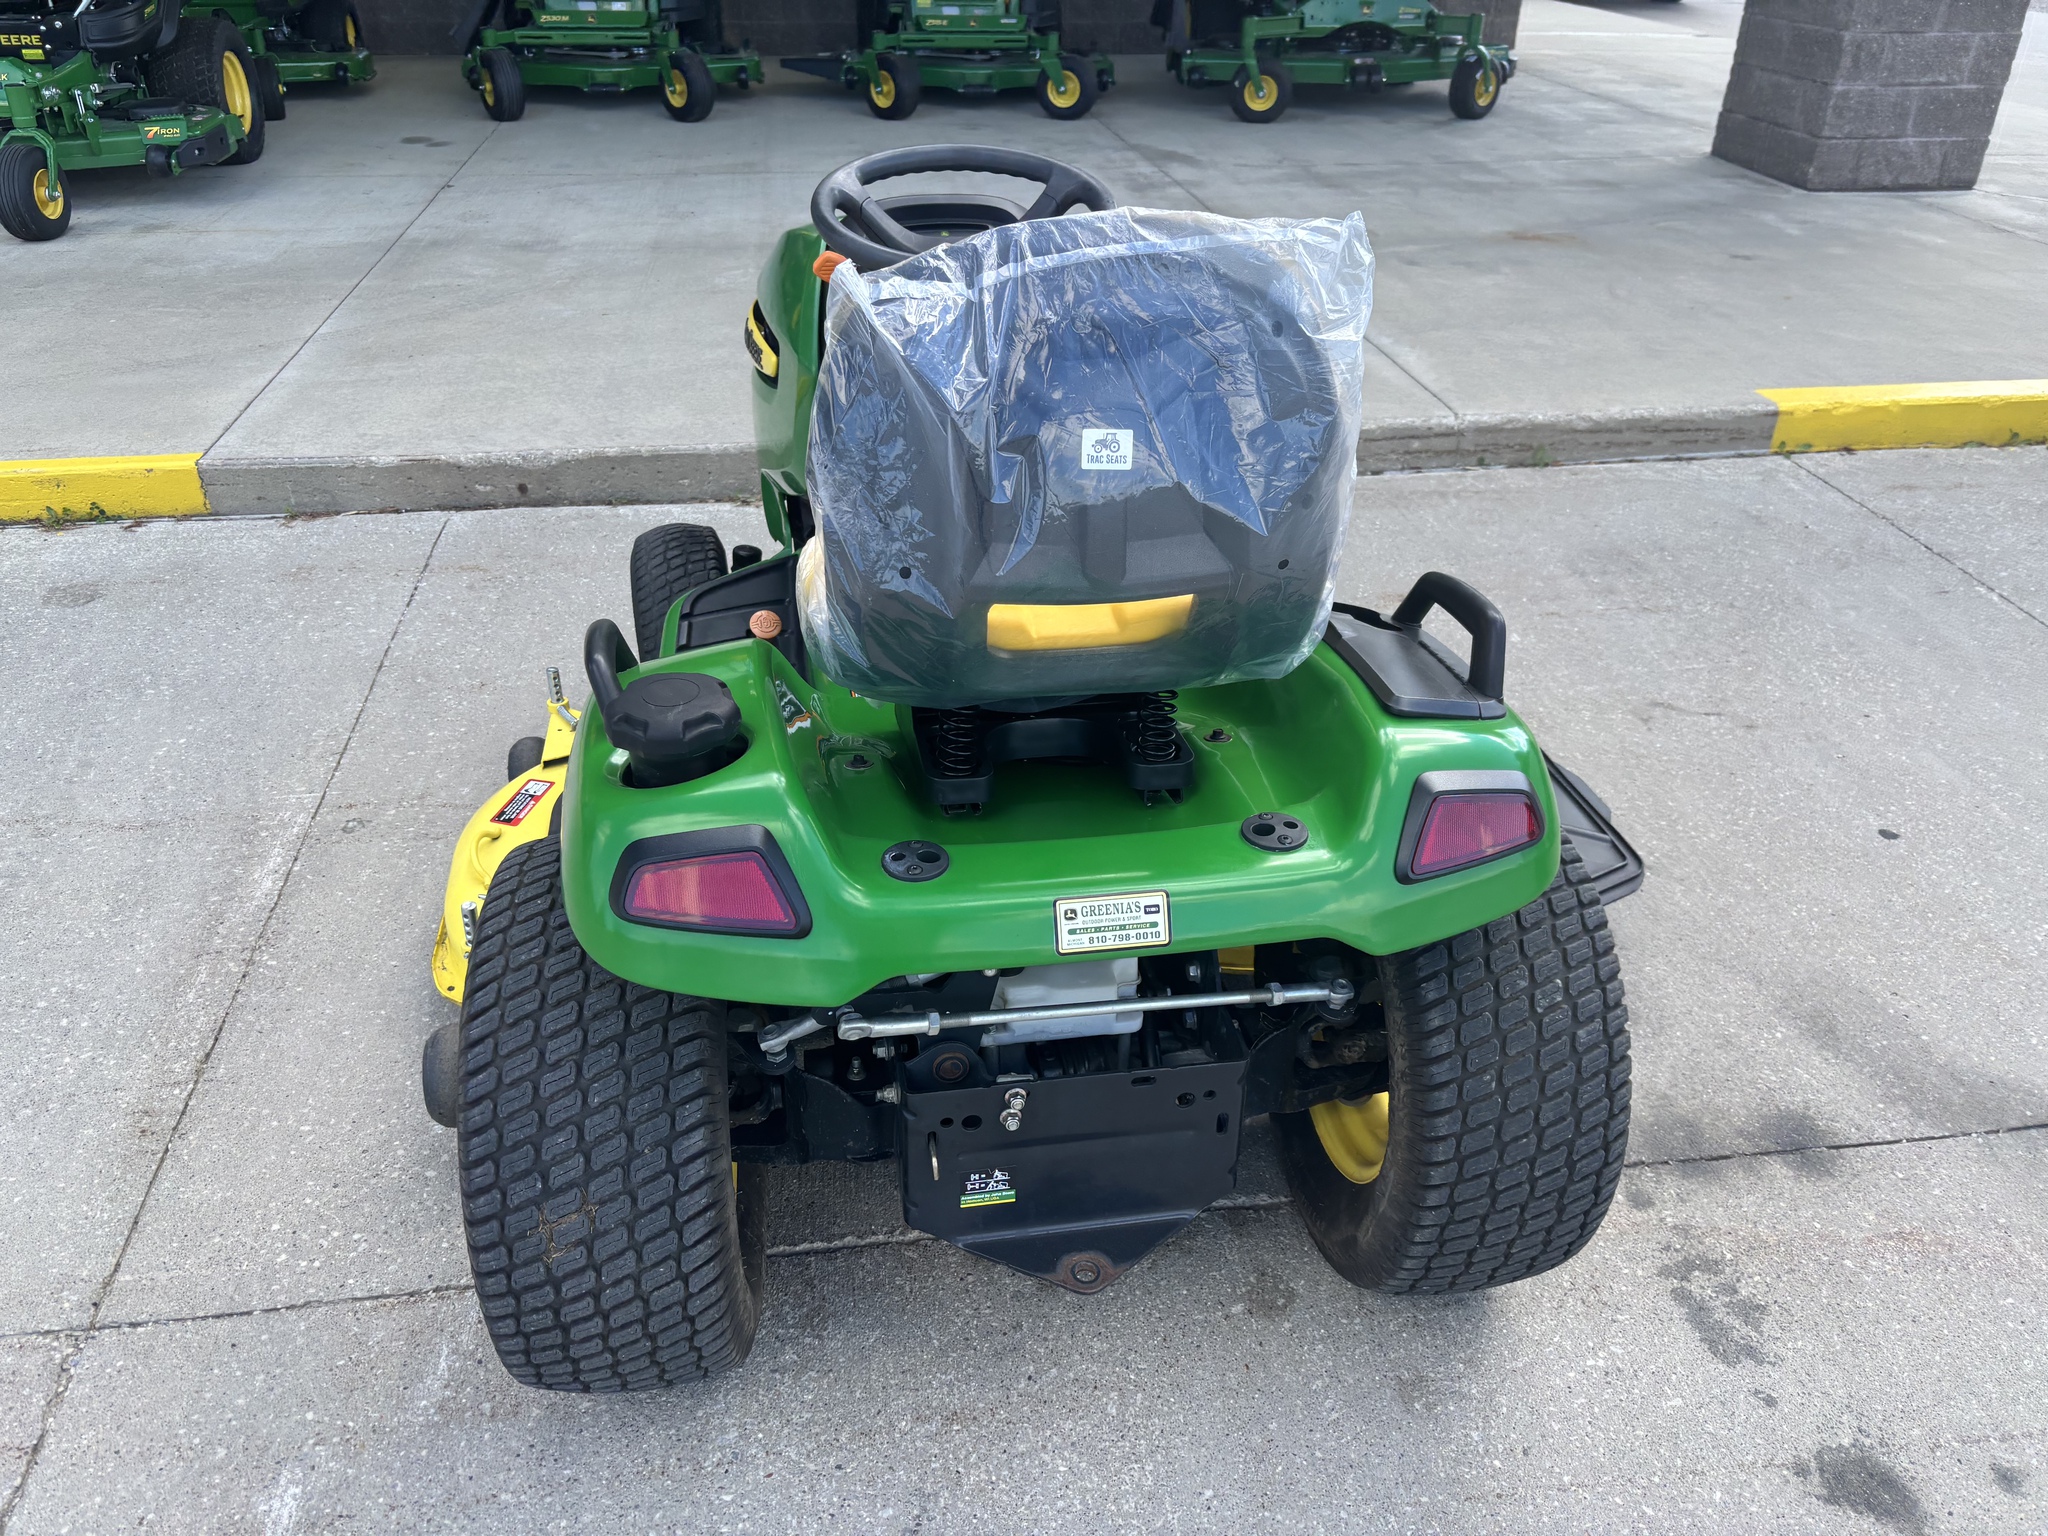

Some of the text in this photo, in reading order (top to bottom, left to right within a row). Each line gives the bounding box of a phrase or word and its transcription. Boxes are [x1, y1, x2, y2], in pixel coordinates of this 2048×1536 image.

[1086, 453, 1127, 464] TRAC SEATS
[1081, 901, 1142, 917] GREENIA'S
[1081, 918, 1105, 926] OUTDOOR
[1075, 926, 1096, 934] SALES
[1125, 923, 1151, 931] SERVICE
[1088, 930, 1161, 945] 810-798-0010
